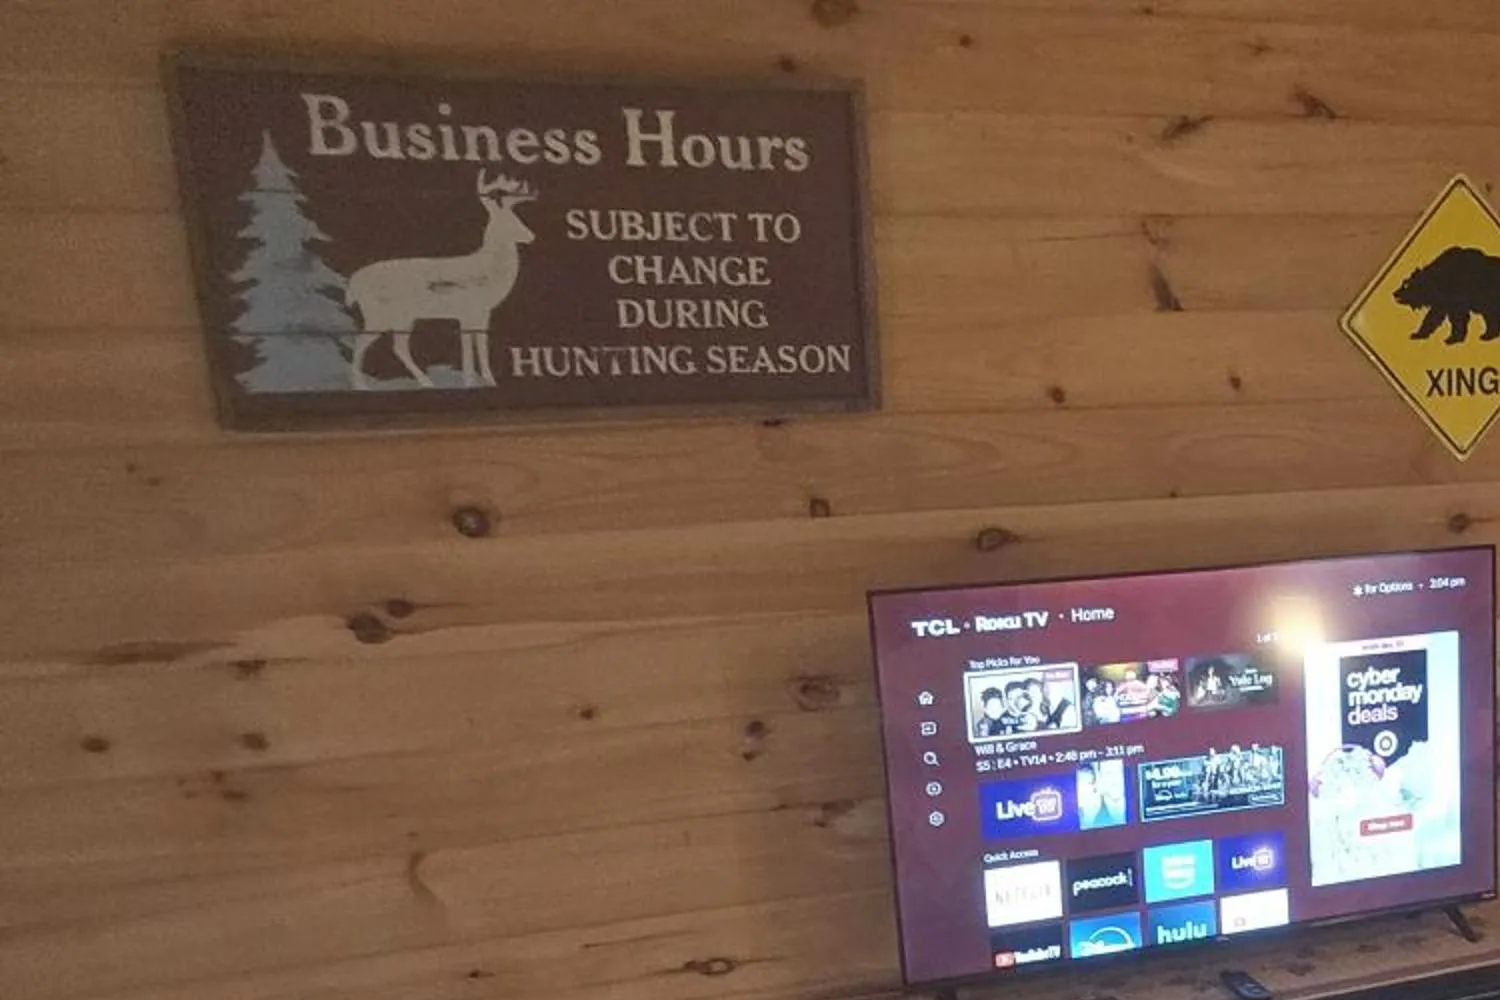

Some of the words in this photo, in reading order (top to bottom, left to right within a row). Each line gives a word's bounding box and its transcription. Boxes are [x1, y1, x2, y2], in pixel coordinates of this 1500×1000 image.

[301, 93, 601, 164] Business
[622, 108, 812, 172] Hours
[565, 210, 738, 243] SUBJECT
[747, 212, 800, 243] TO
[607, 256, 771, 287] CHANGE
[617, 300, 769, 329] DURING
[510, 346, 697, 377] HUNTING
[705, 345, 851, 374] SEASON
[1425, 367, 1500, 398] XING
[1379, 582, 1413, 595] Options
[911, 619, 961, 637] TCL
[975, 615, 1021, 632] Roku
[1023, 611, 1049, 628] TV
[1071, 607, 1115, 622] Home
[1346, 665, 1401, 691] cyber
[1347, 682, 1423, 707] monday
[1347, 703, 1399, 725] deals
[974, 743, 994, 757] Will
[1005, 740, 1037, 754] Grace
[1072, 872, 1128, 896] peacock
[1157, 920, 1208, 945] hulu
